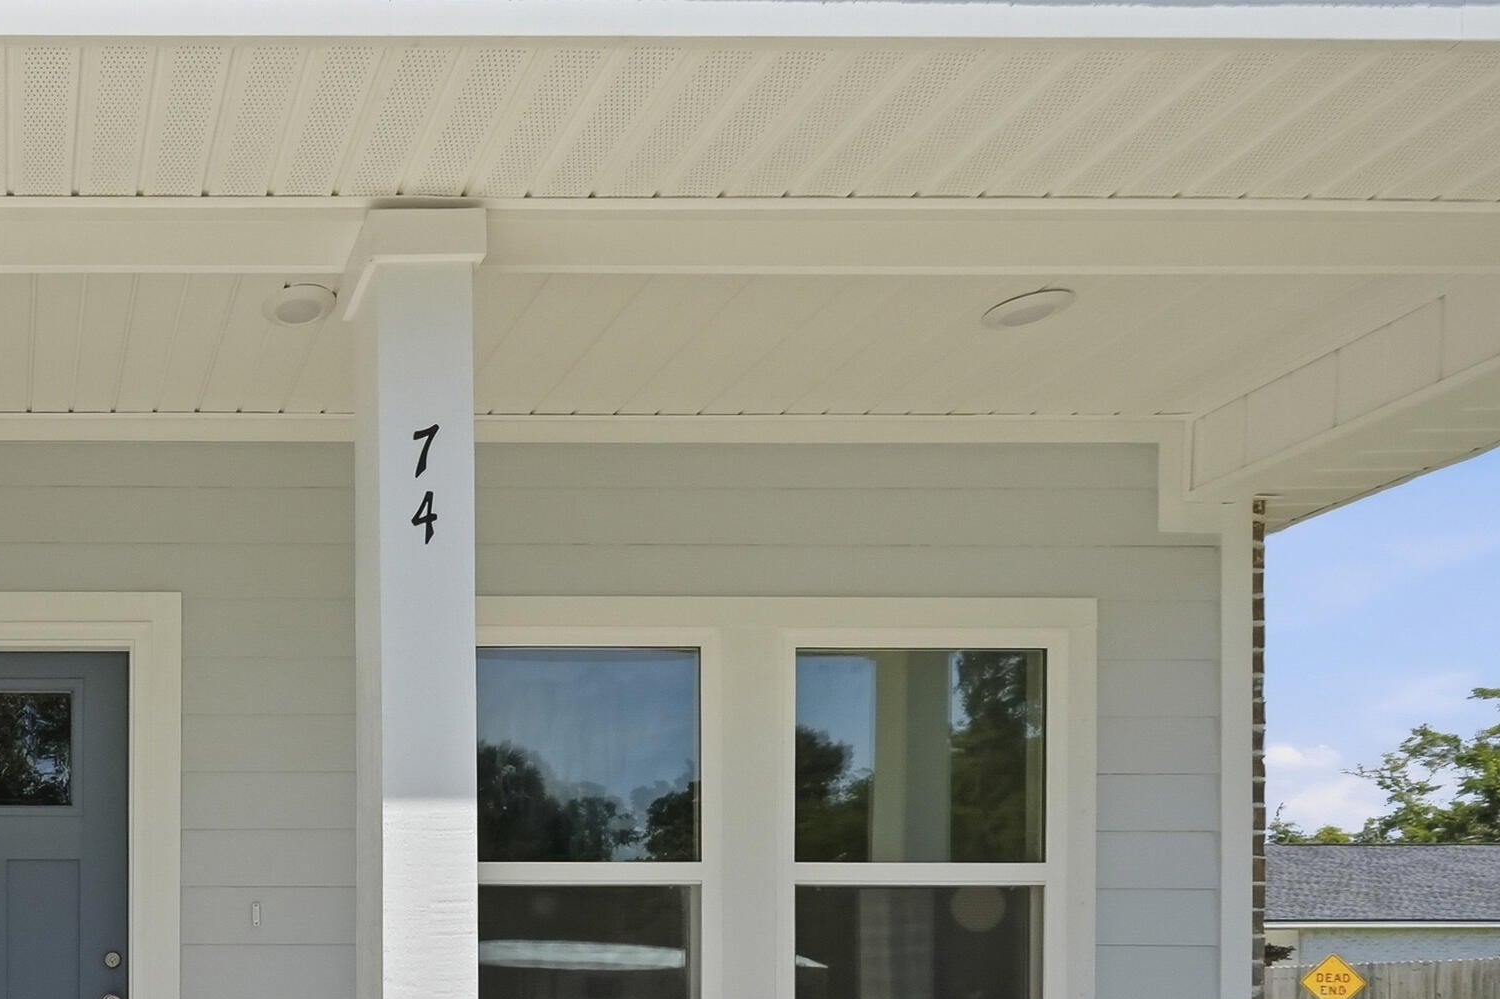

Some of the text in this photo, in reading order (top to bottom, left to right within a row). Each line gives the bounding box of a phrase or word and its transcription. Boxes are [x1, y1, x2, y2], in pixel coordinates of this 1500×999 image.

[411, 424, 440, 545] 74
[1316, 973, 1351, 983] DEAD
[1320, 985, 1347, 996] END
